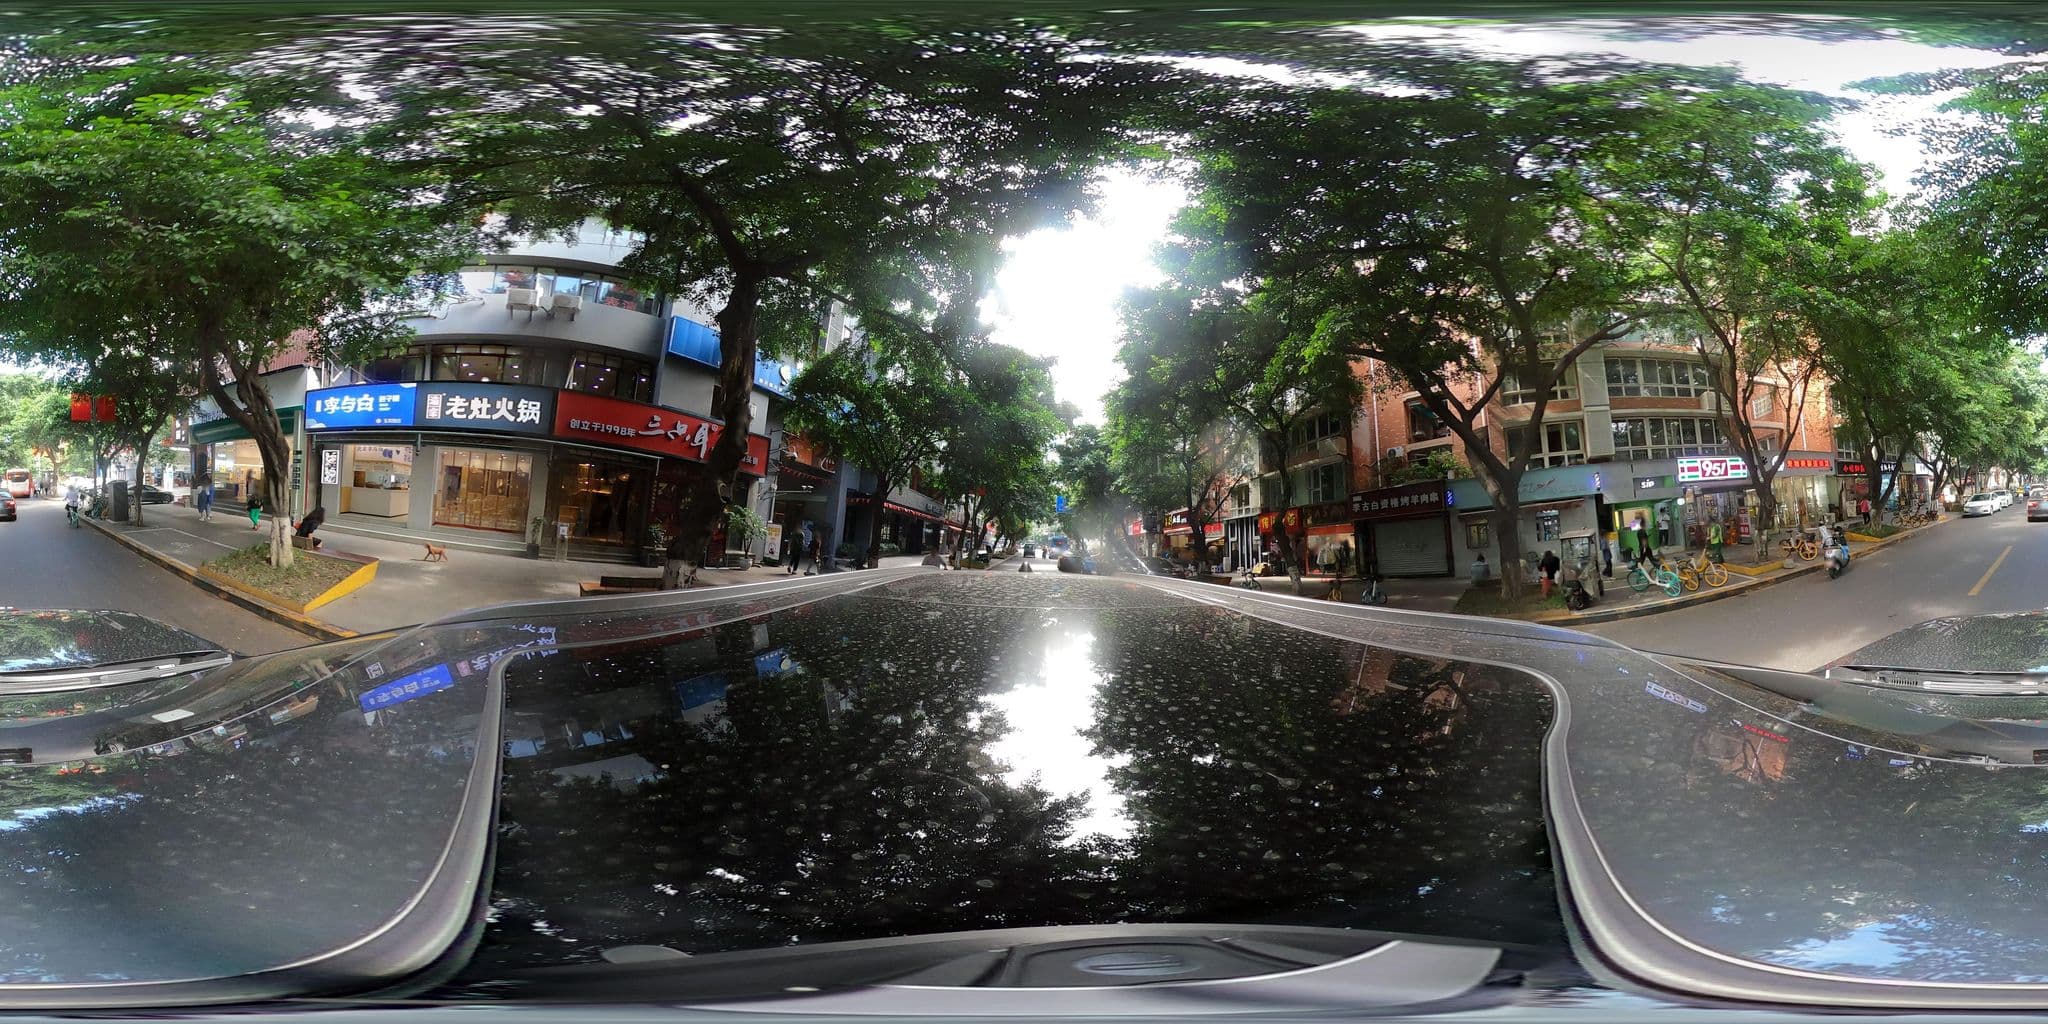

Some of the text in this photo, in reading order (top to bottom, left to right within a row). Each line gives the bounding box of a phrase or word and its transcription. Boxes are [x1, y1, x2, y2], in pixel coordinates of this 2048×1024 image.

[445, 395, 541, 424] 老灶火锅
[570, 418, 636, 437] 创立于1998年
